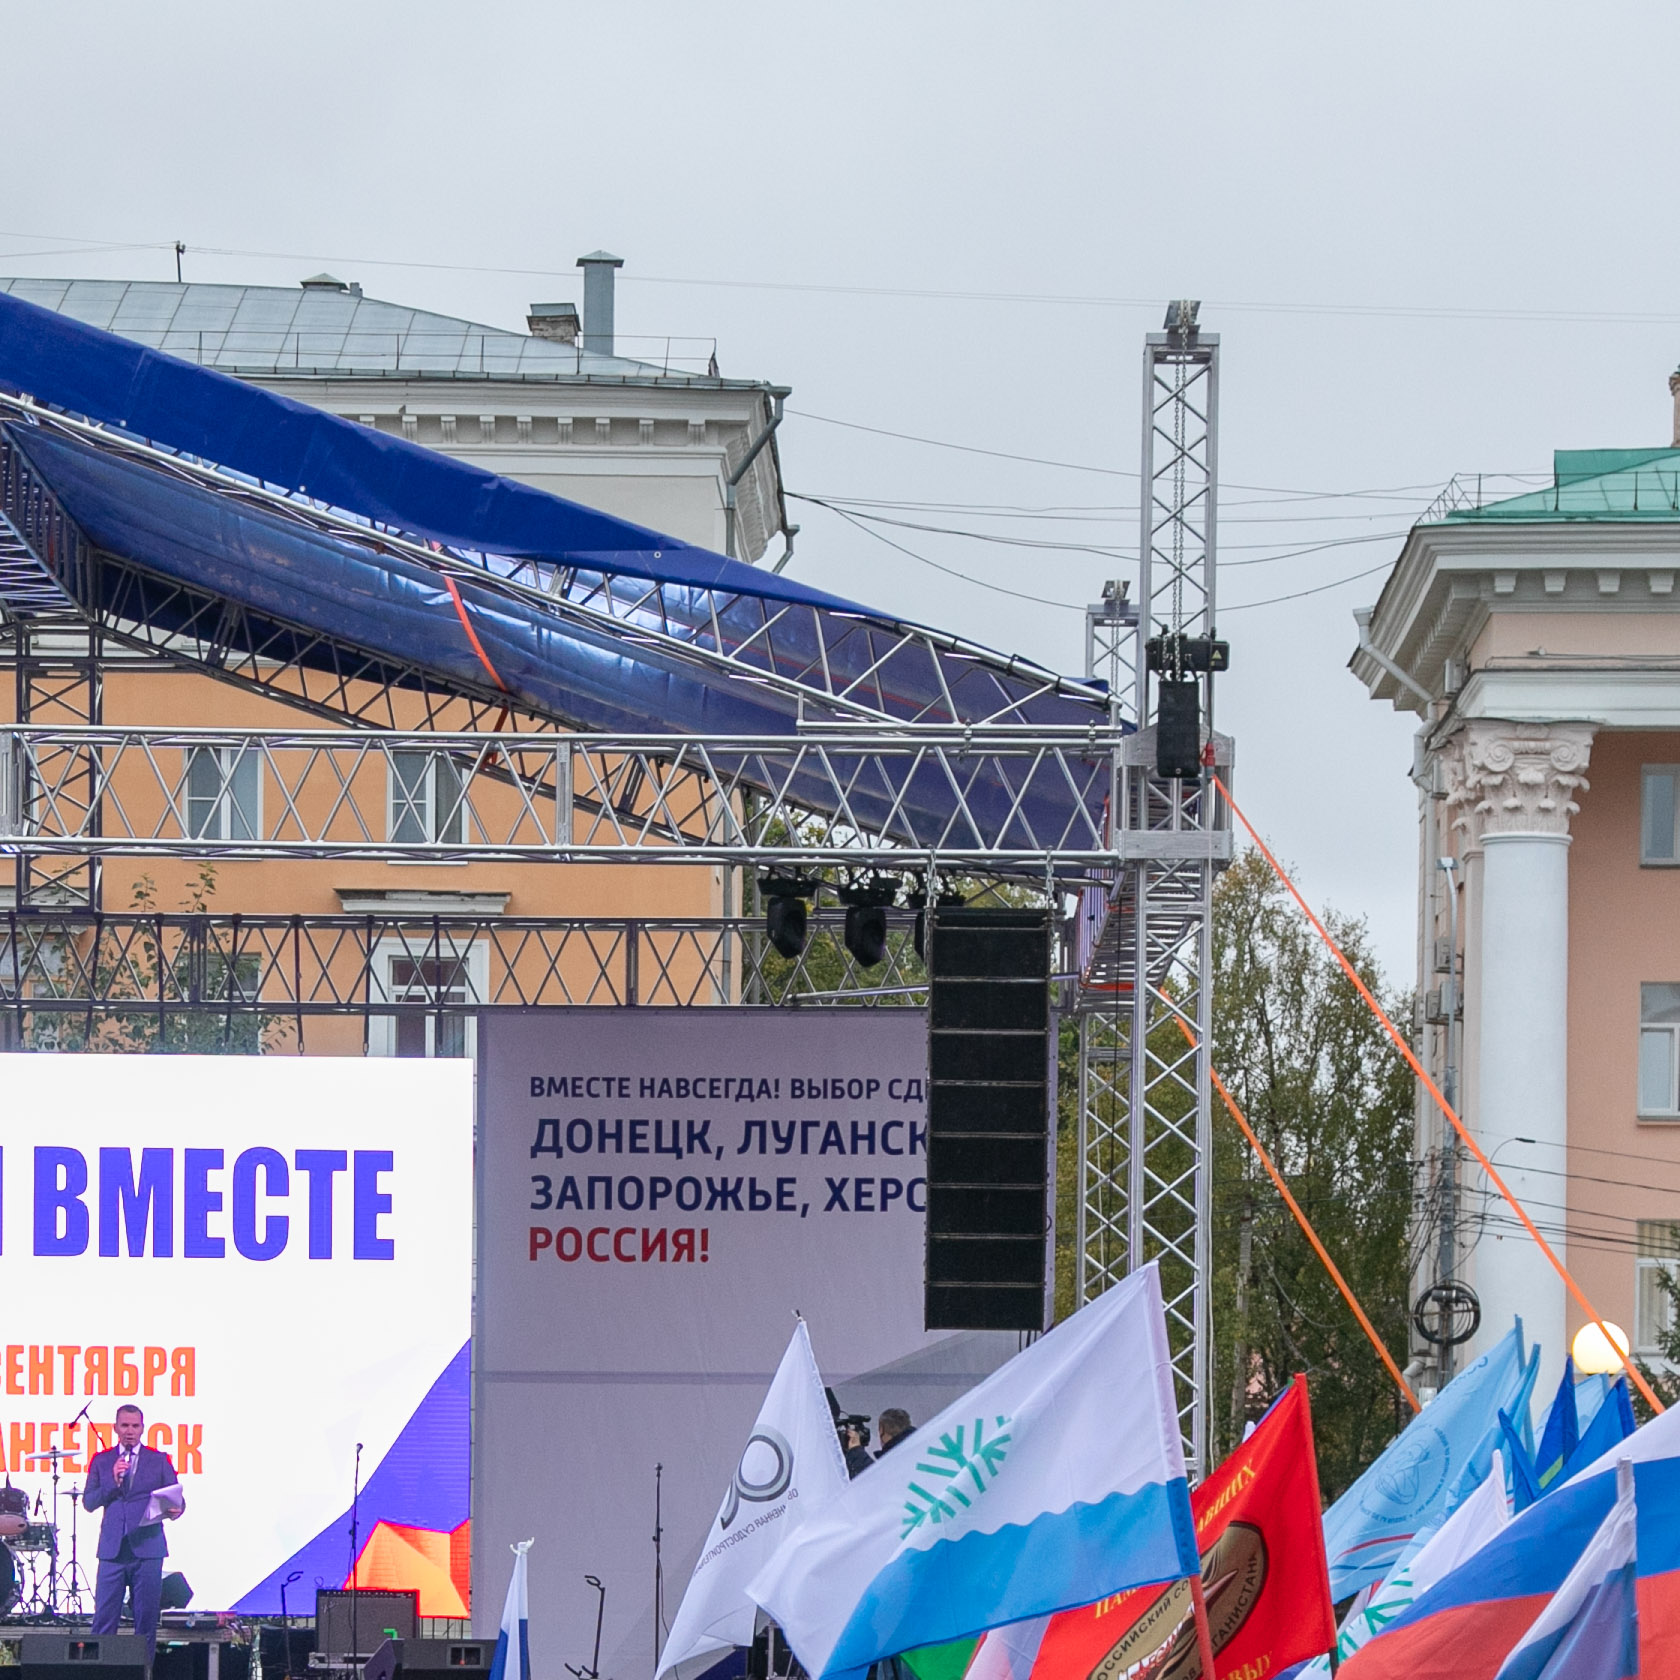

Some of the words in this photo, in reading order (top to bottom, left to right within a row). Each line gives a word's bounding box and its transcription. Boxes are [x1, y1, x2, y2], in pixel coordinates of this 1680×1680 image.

[530, 1076, 631, 1099] ВМЕСТЕ
[639, 1077, 780, 1103] НАВСЕГДА!
[791, 1078, 880, 1100] ВЫБОР
[530, 1118, 724, 1161] ДОНЕЦК,
[32, 1145, 395, 1262] ВМЕСТЕ
[530, 1175, 809, 1218] ЗАПОРОЖЬЕ,
[529, 1226, 710, 1263] РОССИЯ!
